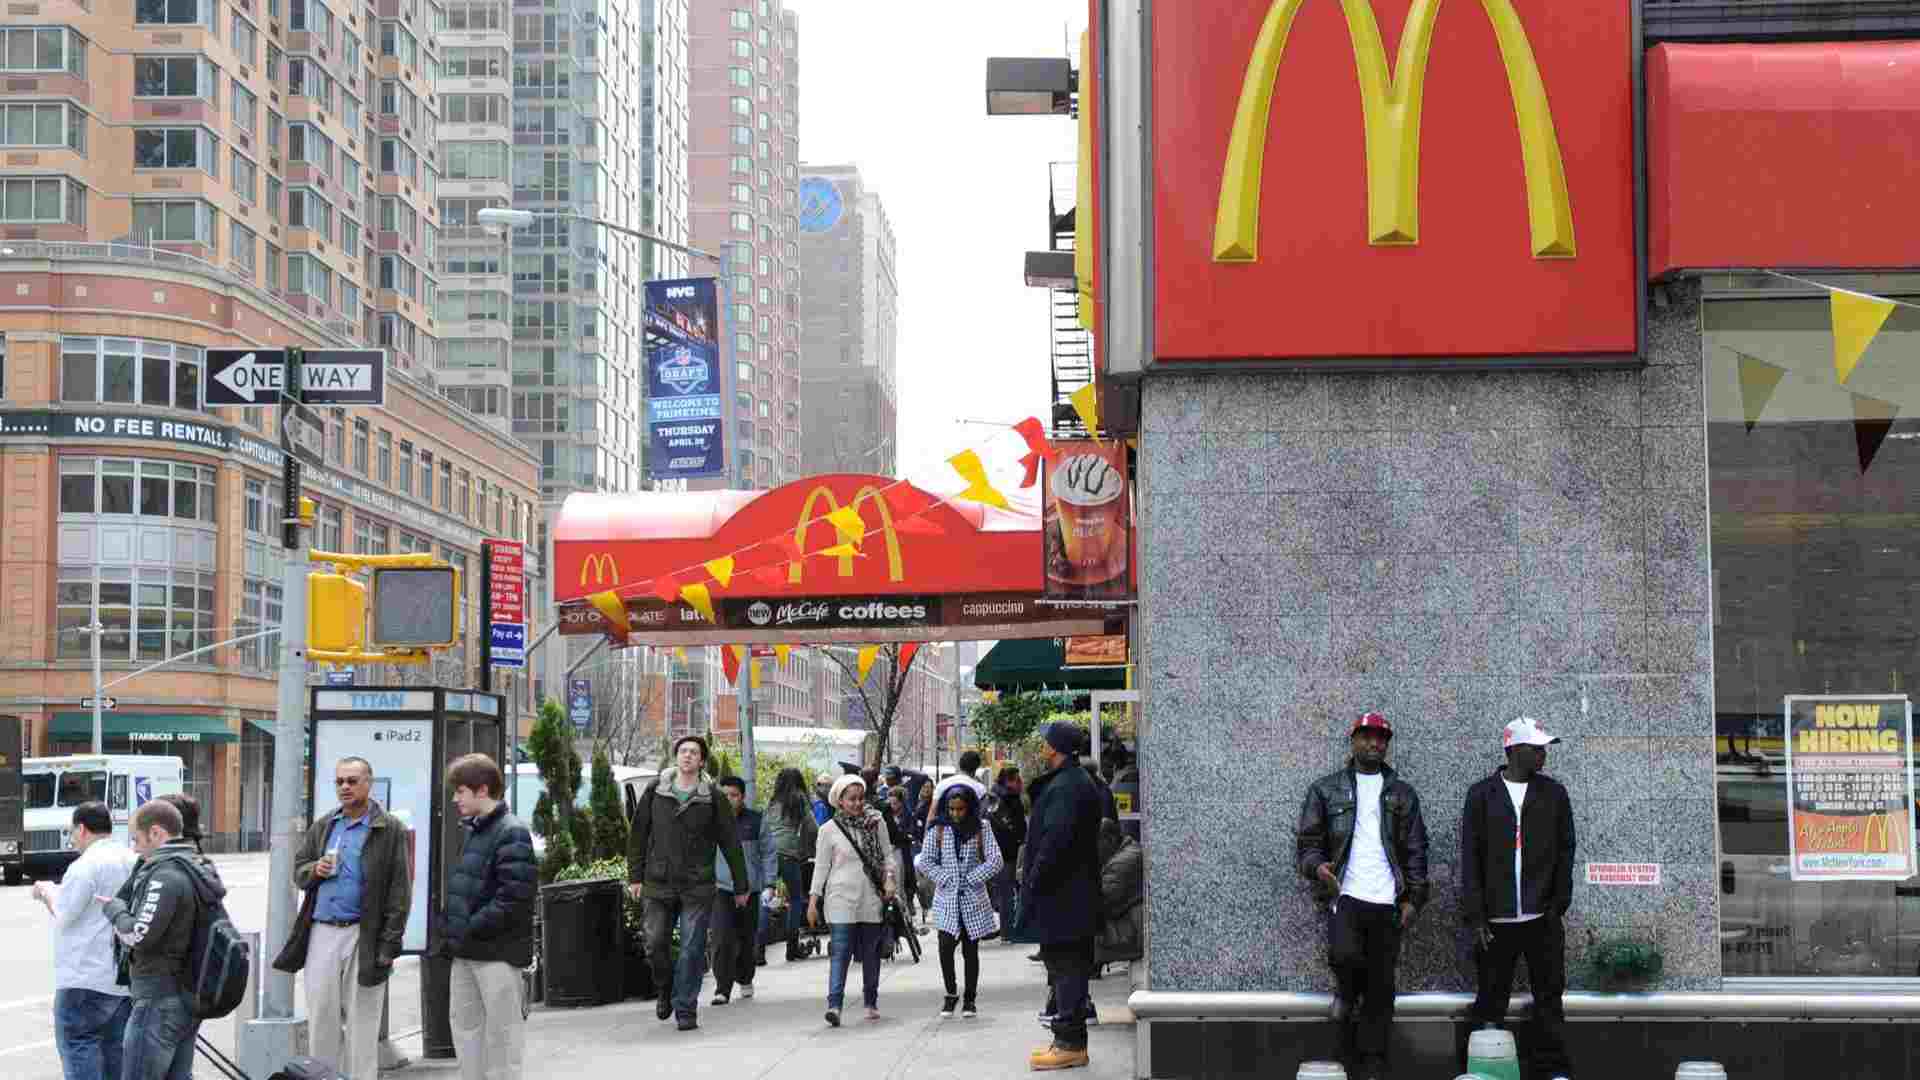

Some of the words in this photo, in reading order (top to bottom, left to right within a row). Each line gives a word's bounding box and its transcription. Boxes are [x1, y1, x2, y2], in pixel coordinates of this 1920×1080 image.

[666, 286, 696, 298] NYC
[233, 366, 282, 388] ONE
[307, 366, 361, 388] WAY
[663, 367, 705, 379] DRAFT
[74, 416, 105, 433] NO
[113, 418, 154, 436] FEE
[657, 424, 715, 437] THURSDAY
[775, 601, 830, 622] McCafé
[838, 602, 927, 621] coffees
[962, 600, 1025, 617] cappuccino
[351, 692, 404, 709] TITAN
[1815, 703, 1880, 729] NOW
[128, 732, 173, 742] STARBUCKS
[1799, 729, 1898, 753] HIRING
